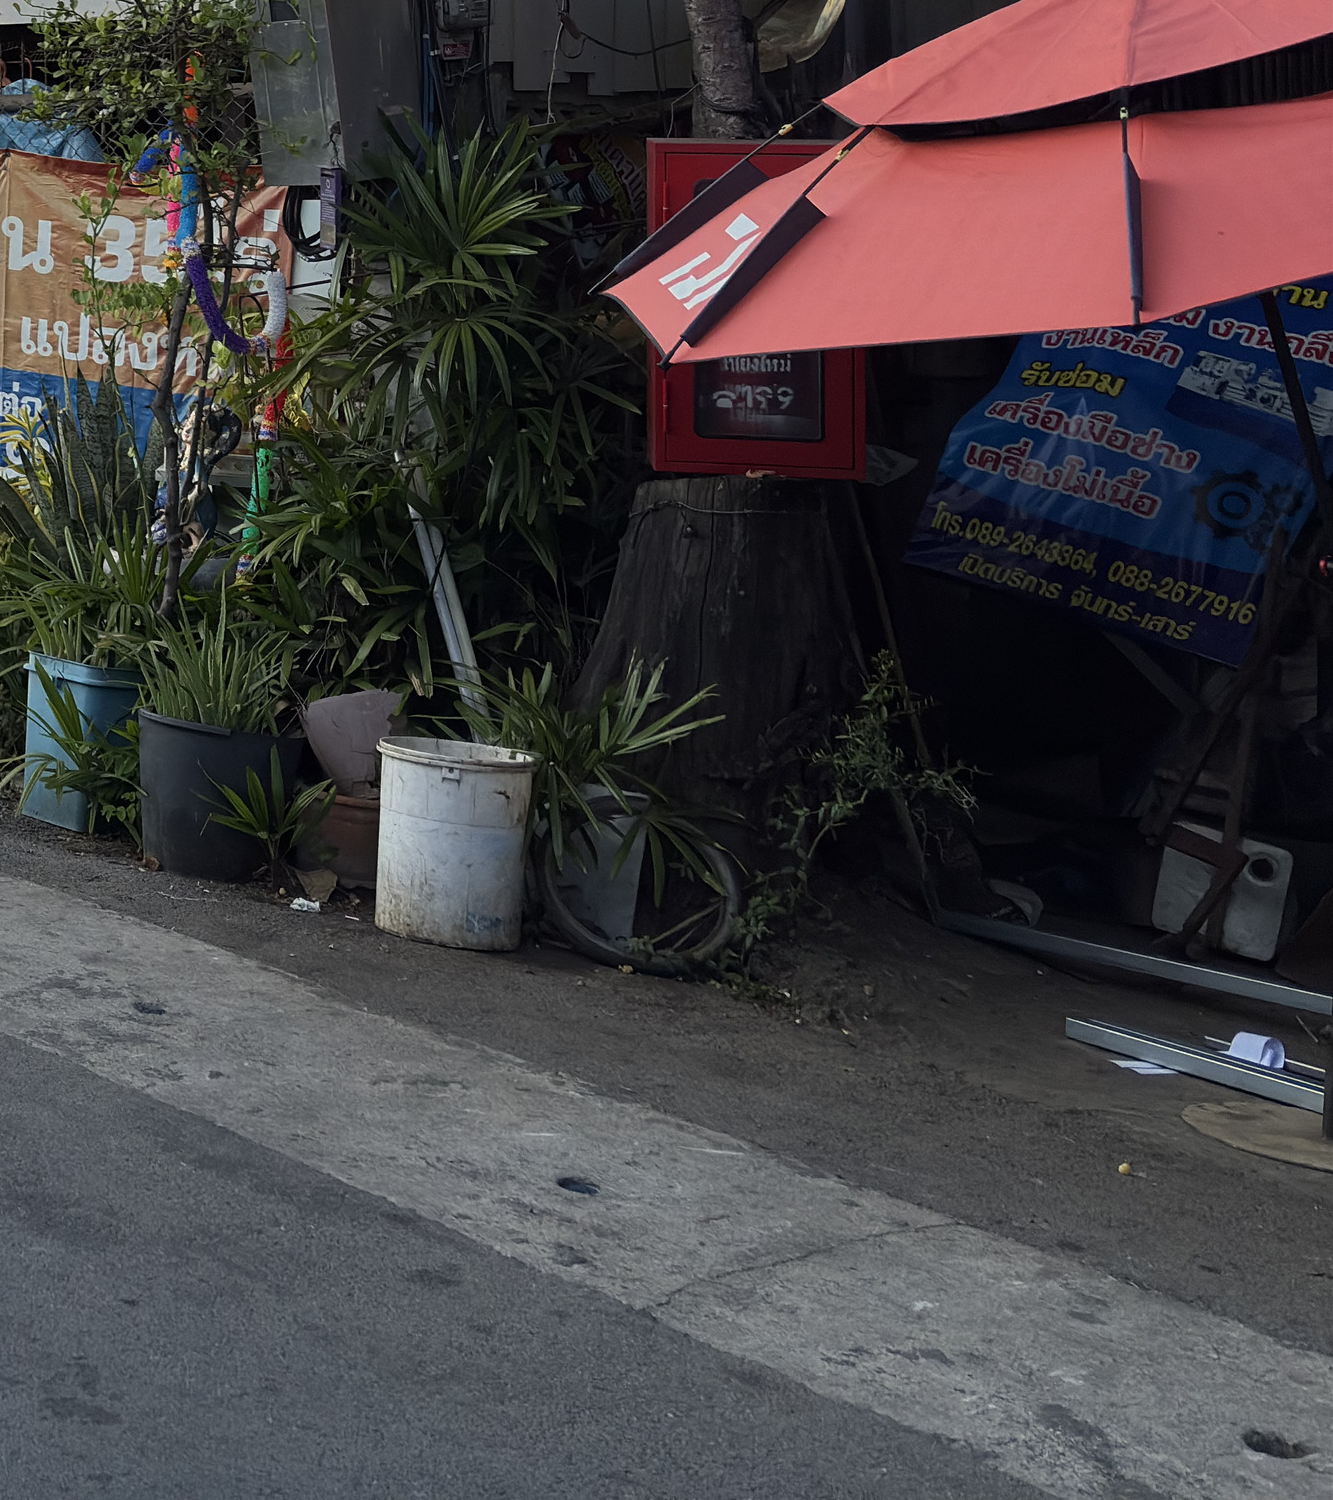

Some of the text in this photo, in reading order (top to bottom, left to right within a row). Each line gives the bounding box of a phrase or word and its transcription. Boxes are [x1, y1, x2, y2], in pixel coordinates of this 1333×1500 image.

[1042, 328, 1183, 368] งานเหล็ก
[1020, 361, 1125, 397] รับซ่อม
[986, 392, 1200, 473] เครื่องมือช่าง
[964, 437, 1162, 519] เครื่องโม่เนื้อ
[957, 553, 1063, 599] เปิดบริการ
[1108, 560, 1257, 625] 088-2677916
